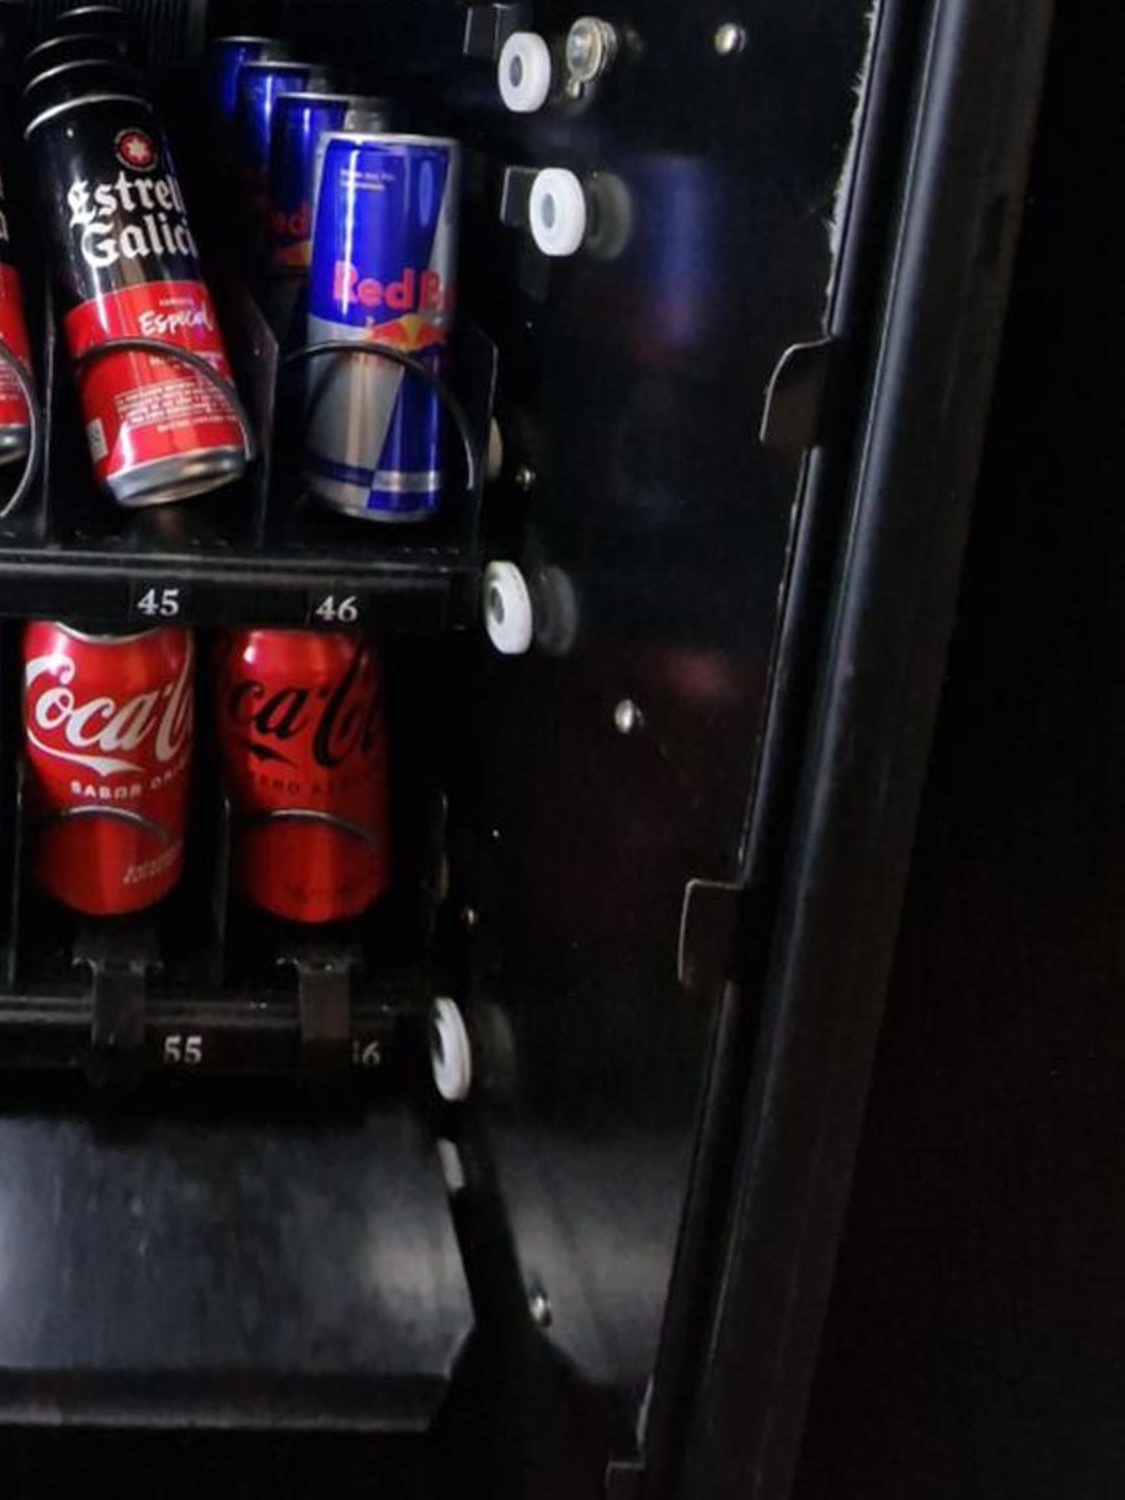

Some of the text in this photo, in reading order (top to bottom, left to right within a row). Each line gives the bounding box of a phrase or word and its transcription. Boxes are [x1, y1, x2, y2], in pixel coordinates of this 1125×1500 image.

[332, 259, 413, 309] Red
[137, 588, 180, 616] 45
[315, 595, 358, 622] 46
[69, 779, 142, 801] SABOR
[164, 1035, 204, 1064] 55
